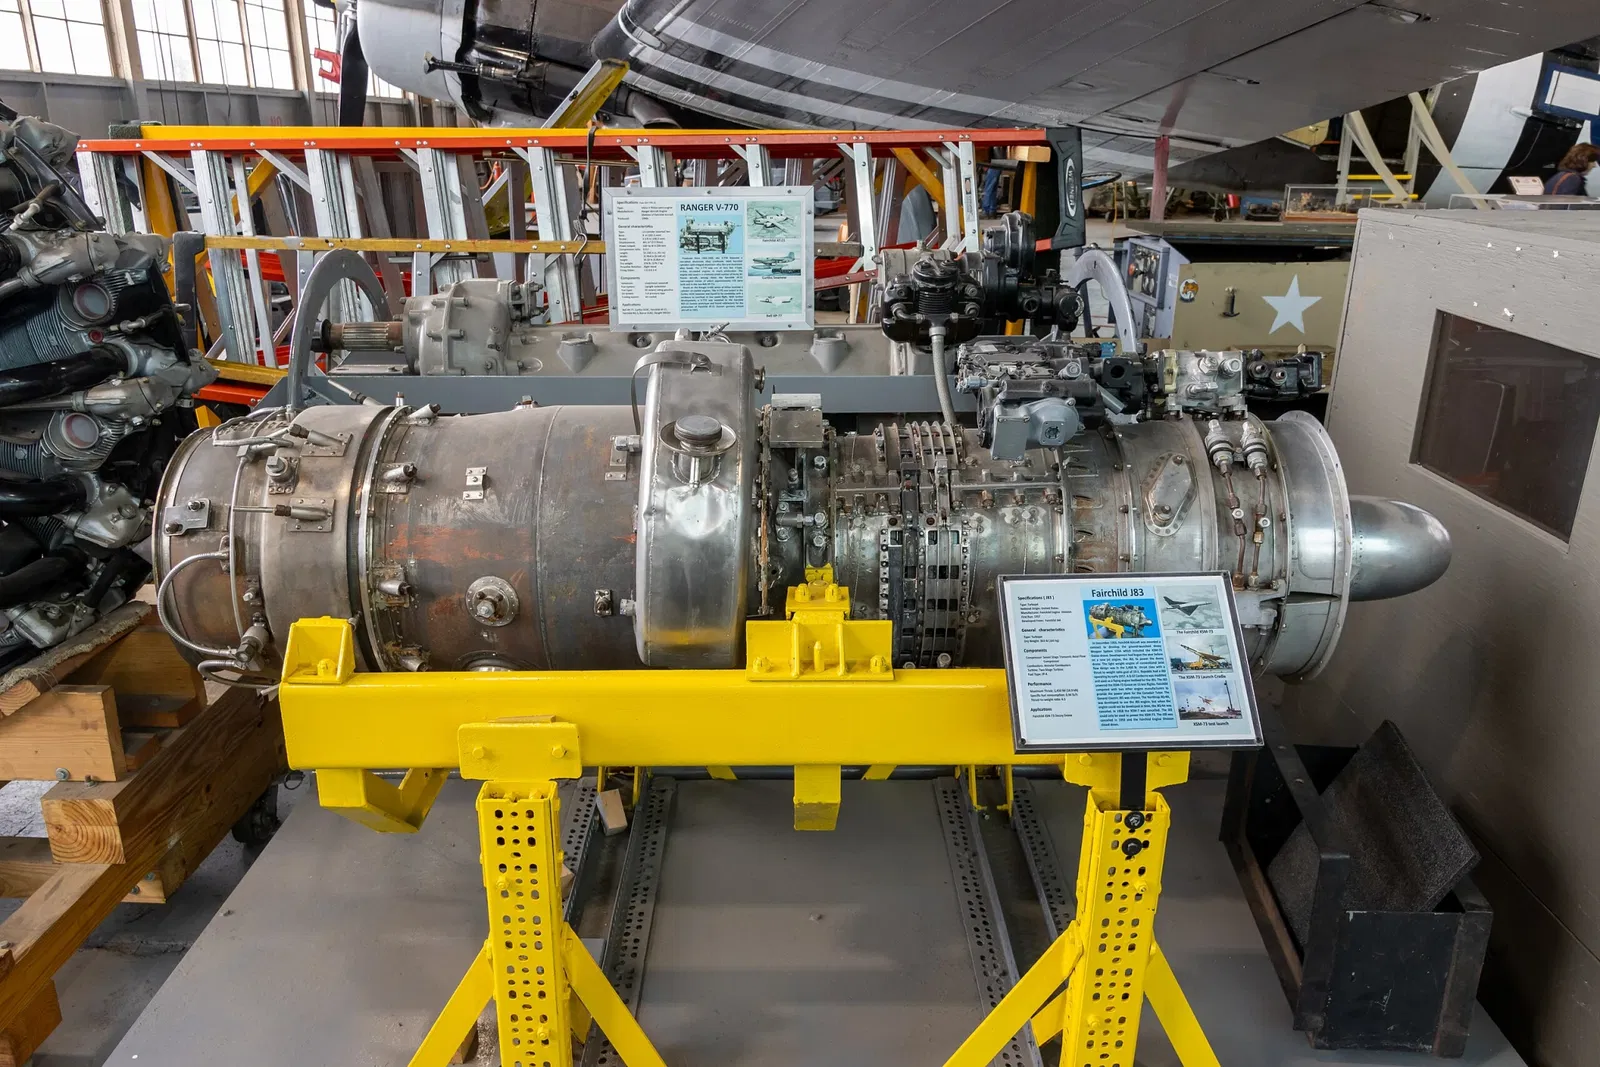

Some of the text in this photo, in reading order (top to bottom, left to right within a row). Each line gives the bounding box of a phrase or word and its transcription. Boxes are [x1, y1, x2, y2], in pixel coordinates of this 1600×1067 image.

[680, 203, 714, 211] RANGER
[1092, 588, 1144, 598] Fairchild J83
